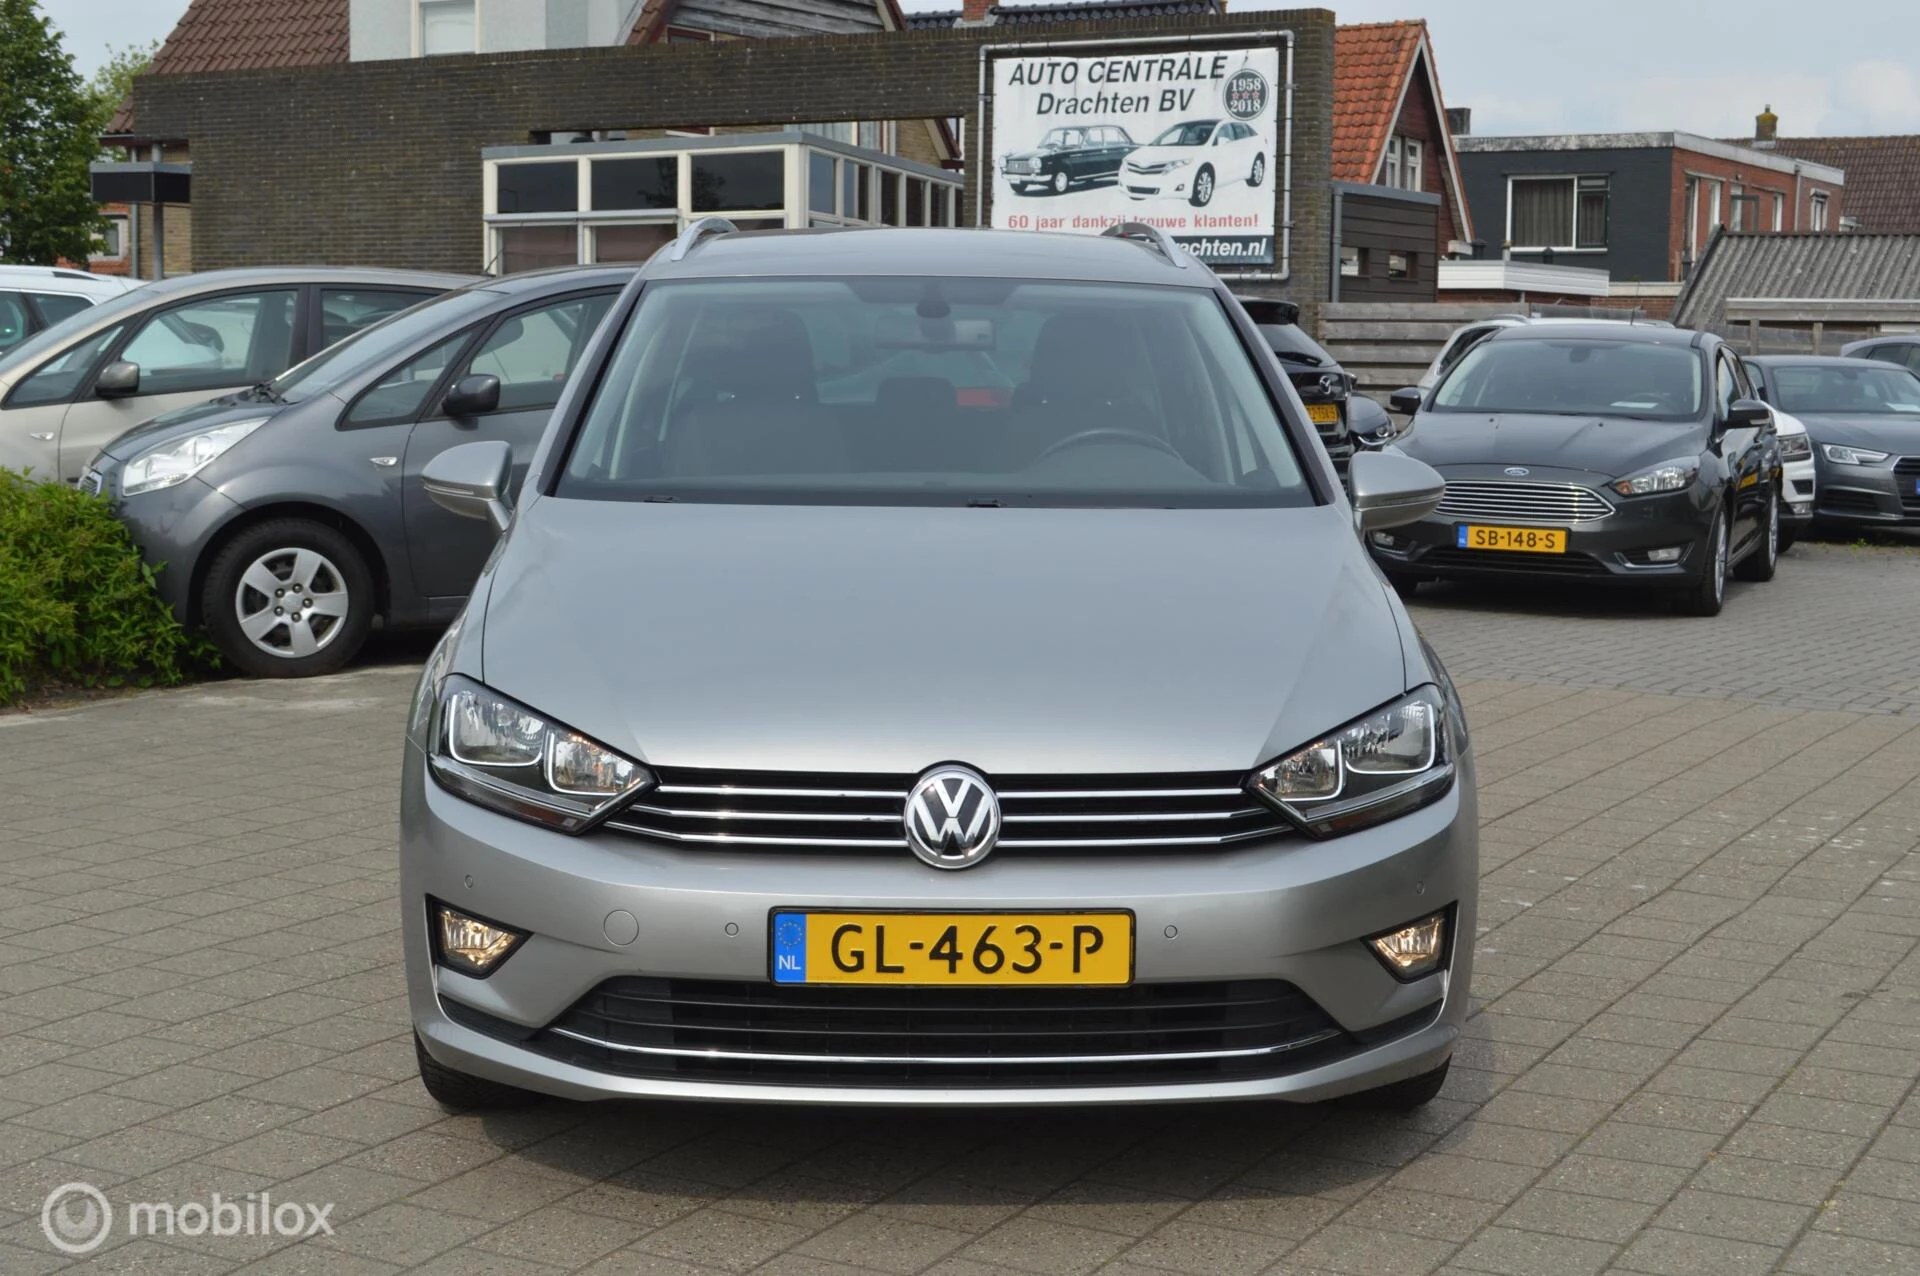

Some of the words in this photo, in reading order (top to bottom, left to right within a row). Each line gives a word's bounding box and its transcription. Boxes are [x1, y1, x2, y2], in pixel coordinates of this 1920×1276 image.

[1008, 61, 1079, 86] AUTO
[1087, 55, 1228, 84] CENTRALE
[1231, 77, 1261, 92] 1958
[1036, 91, 1150, 115] Drachten
[1158, 88, 1195, 112] BV
[1230, 99, 1261, 112] 2018
[1007, 215, 1029, 229] 60
[1035, 216, 1065, 231] jaar
[1194, 213, 1259, 228] klanten!
[1475, 529, 1556, 549] SB-148-S
[778, 953, 802, 971] NL
[831, 923, 1104, 974] GL-463-P
